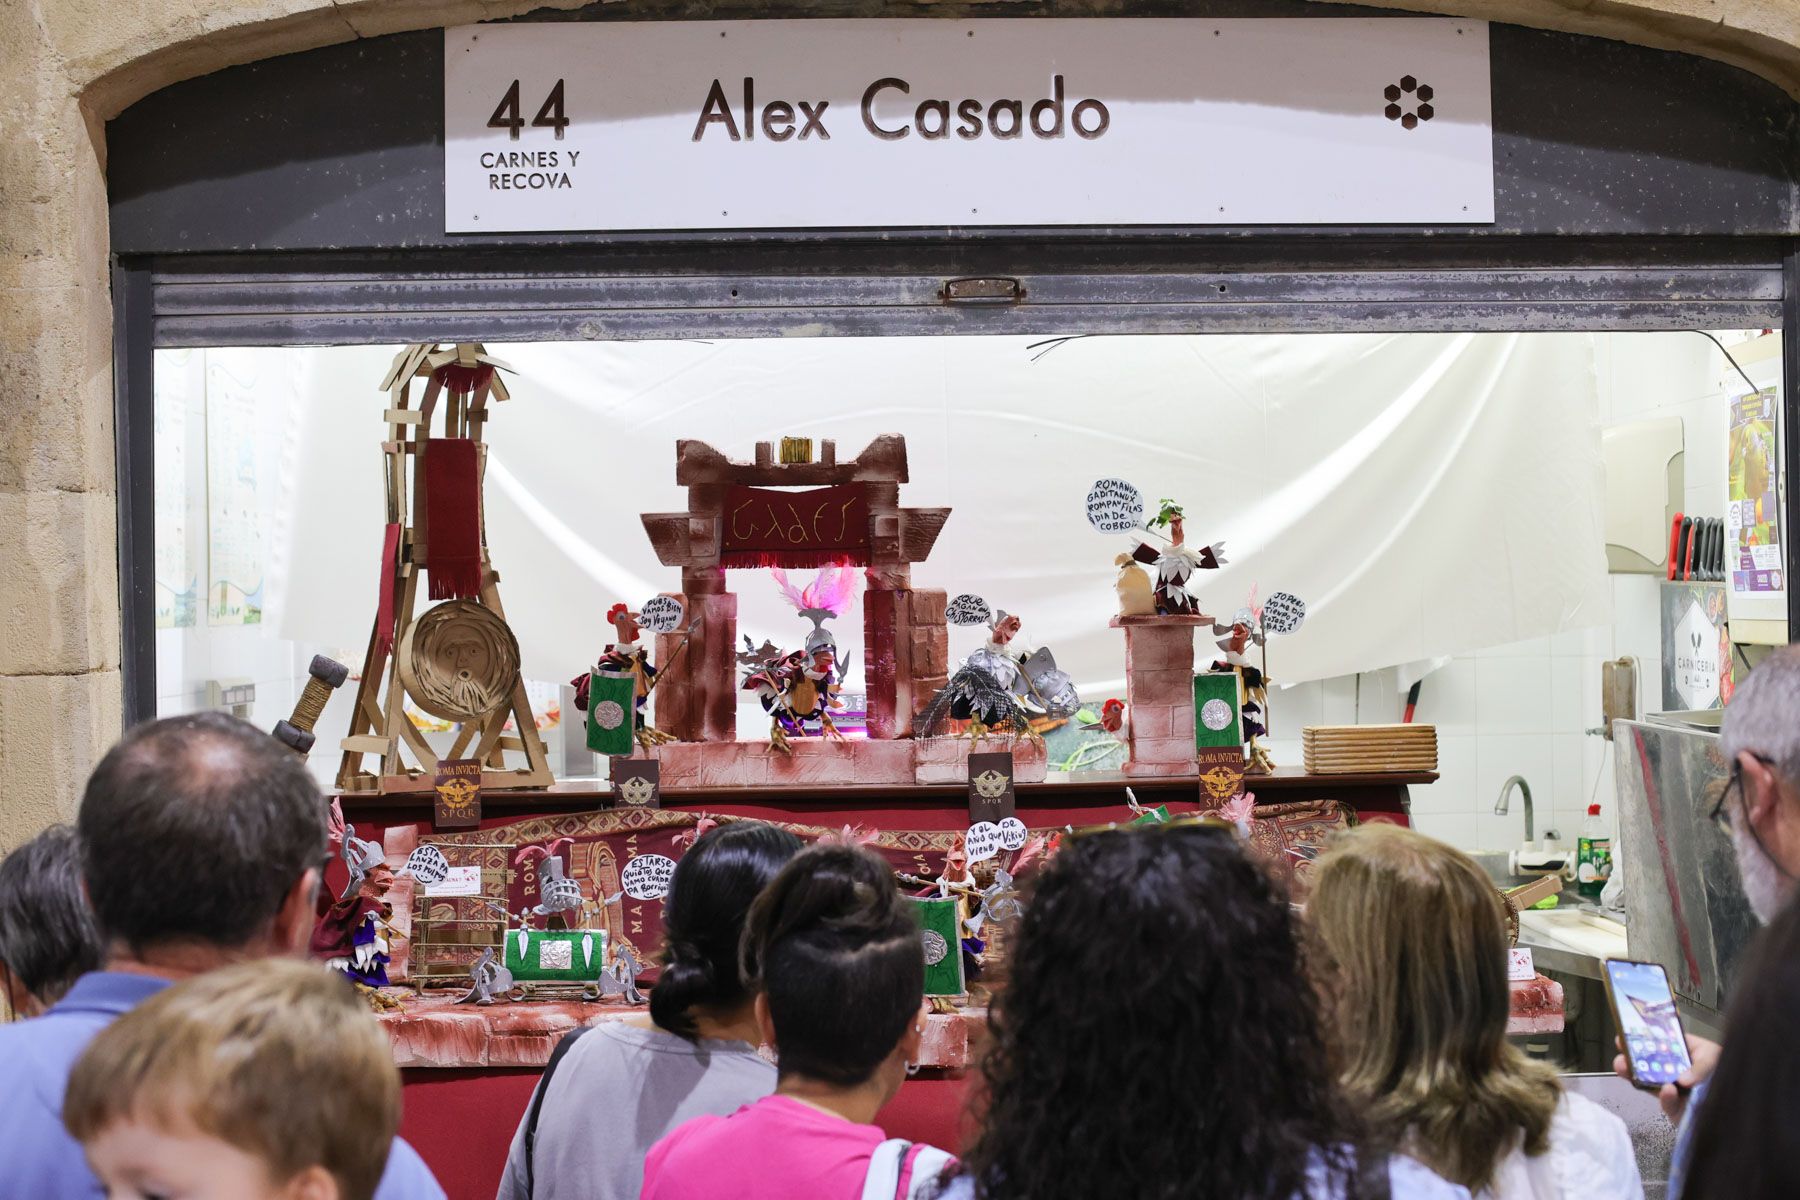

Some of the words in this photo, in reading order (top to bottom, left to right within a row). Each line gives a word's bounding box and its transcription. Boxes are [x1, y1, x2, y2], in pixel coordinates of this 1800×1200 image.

[486, 78, 570, 141] 44
[691, 75, 831, 143] Alex
[859, 74, 1111, 142] Casado
[479, 151, 559, 170] CARNES
[567, 151, 581, 169] Y
[488, 172, 573, 190] RECOVA
[1198, 753, 1217, 764] ROMA
[1217, 752, 1244, 763] INVICTA
[455, 764, 481, 775] INVICTA
[441, 808, 475, 819] SPQR
[407, 862, 422, 871] LOS
